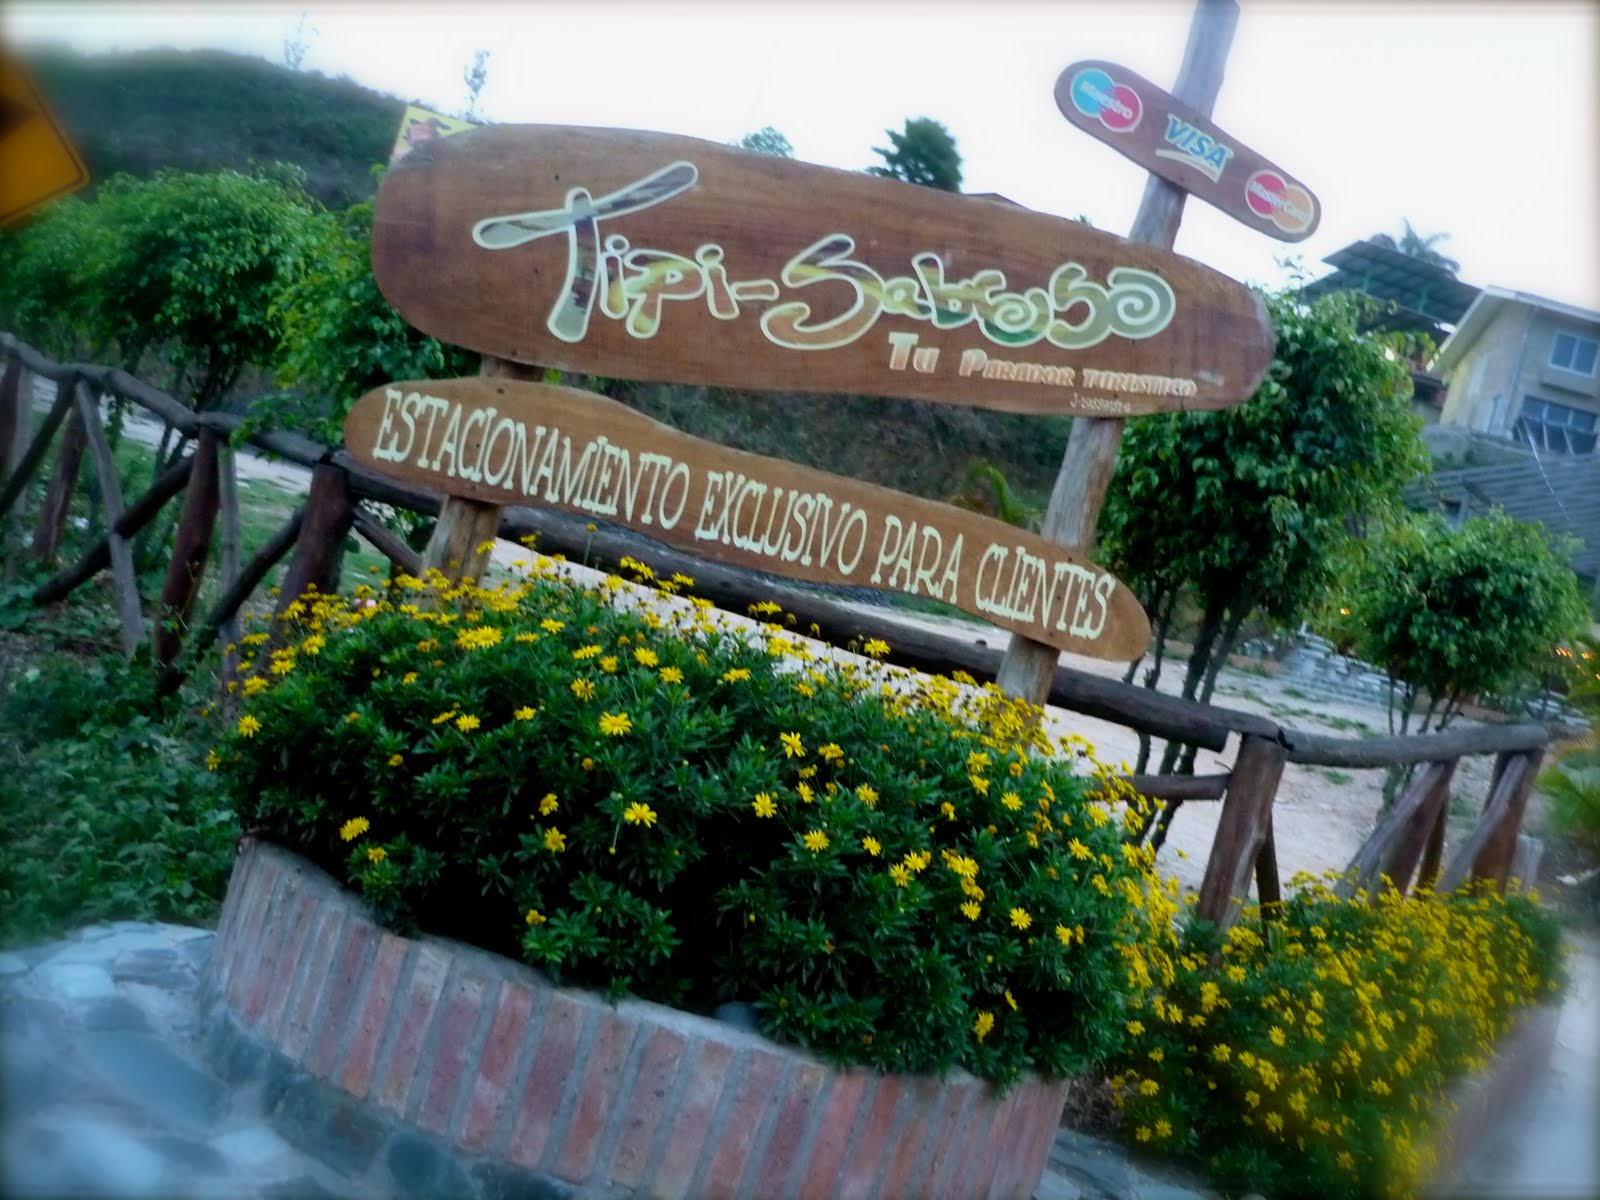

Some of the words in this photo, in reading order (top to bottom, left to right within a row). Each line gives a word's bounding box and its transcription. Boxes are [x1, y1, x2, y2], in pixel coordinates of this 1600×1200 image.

[1168, 113, 1234, 170] VISA
[371, 388, 690, 530] ESTACIONAMIENTO
[694, 470, 867, 576] EXCLUSIVO
[870, 514, 963, 604] PARA
[975, 543, 1116, 640] CLIENTES
